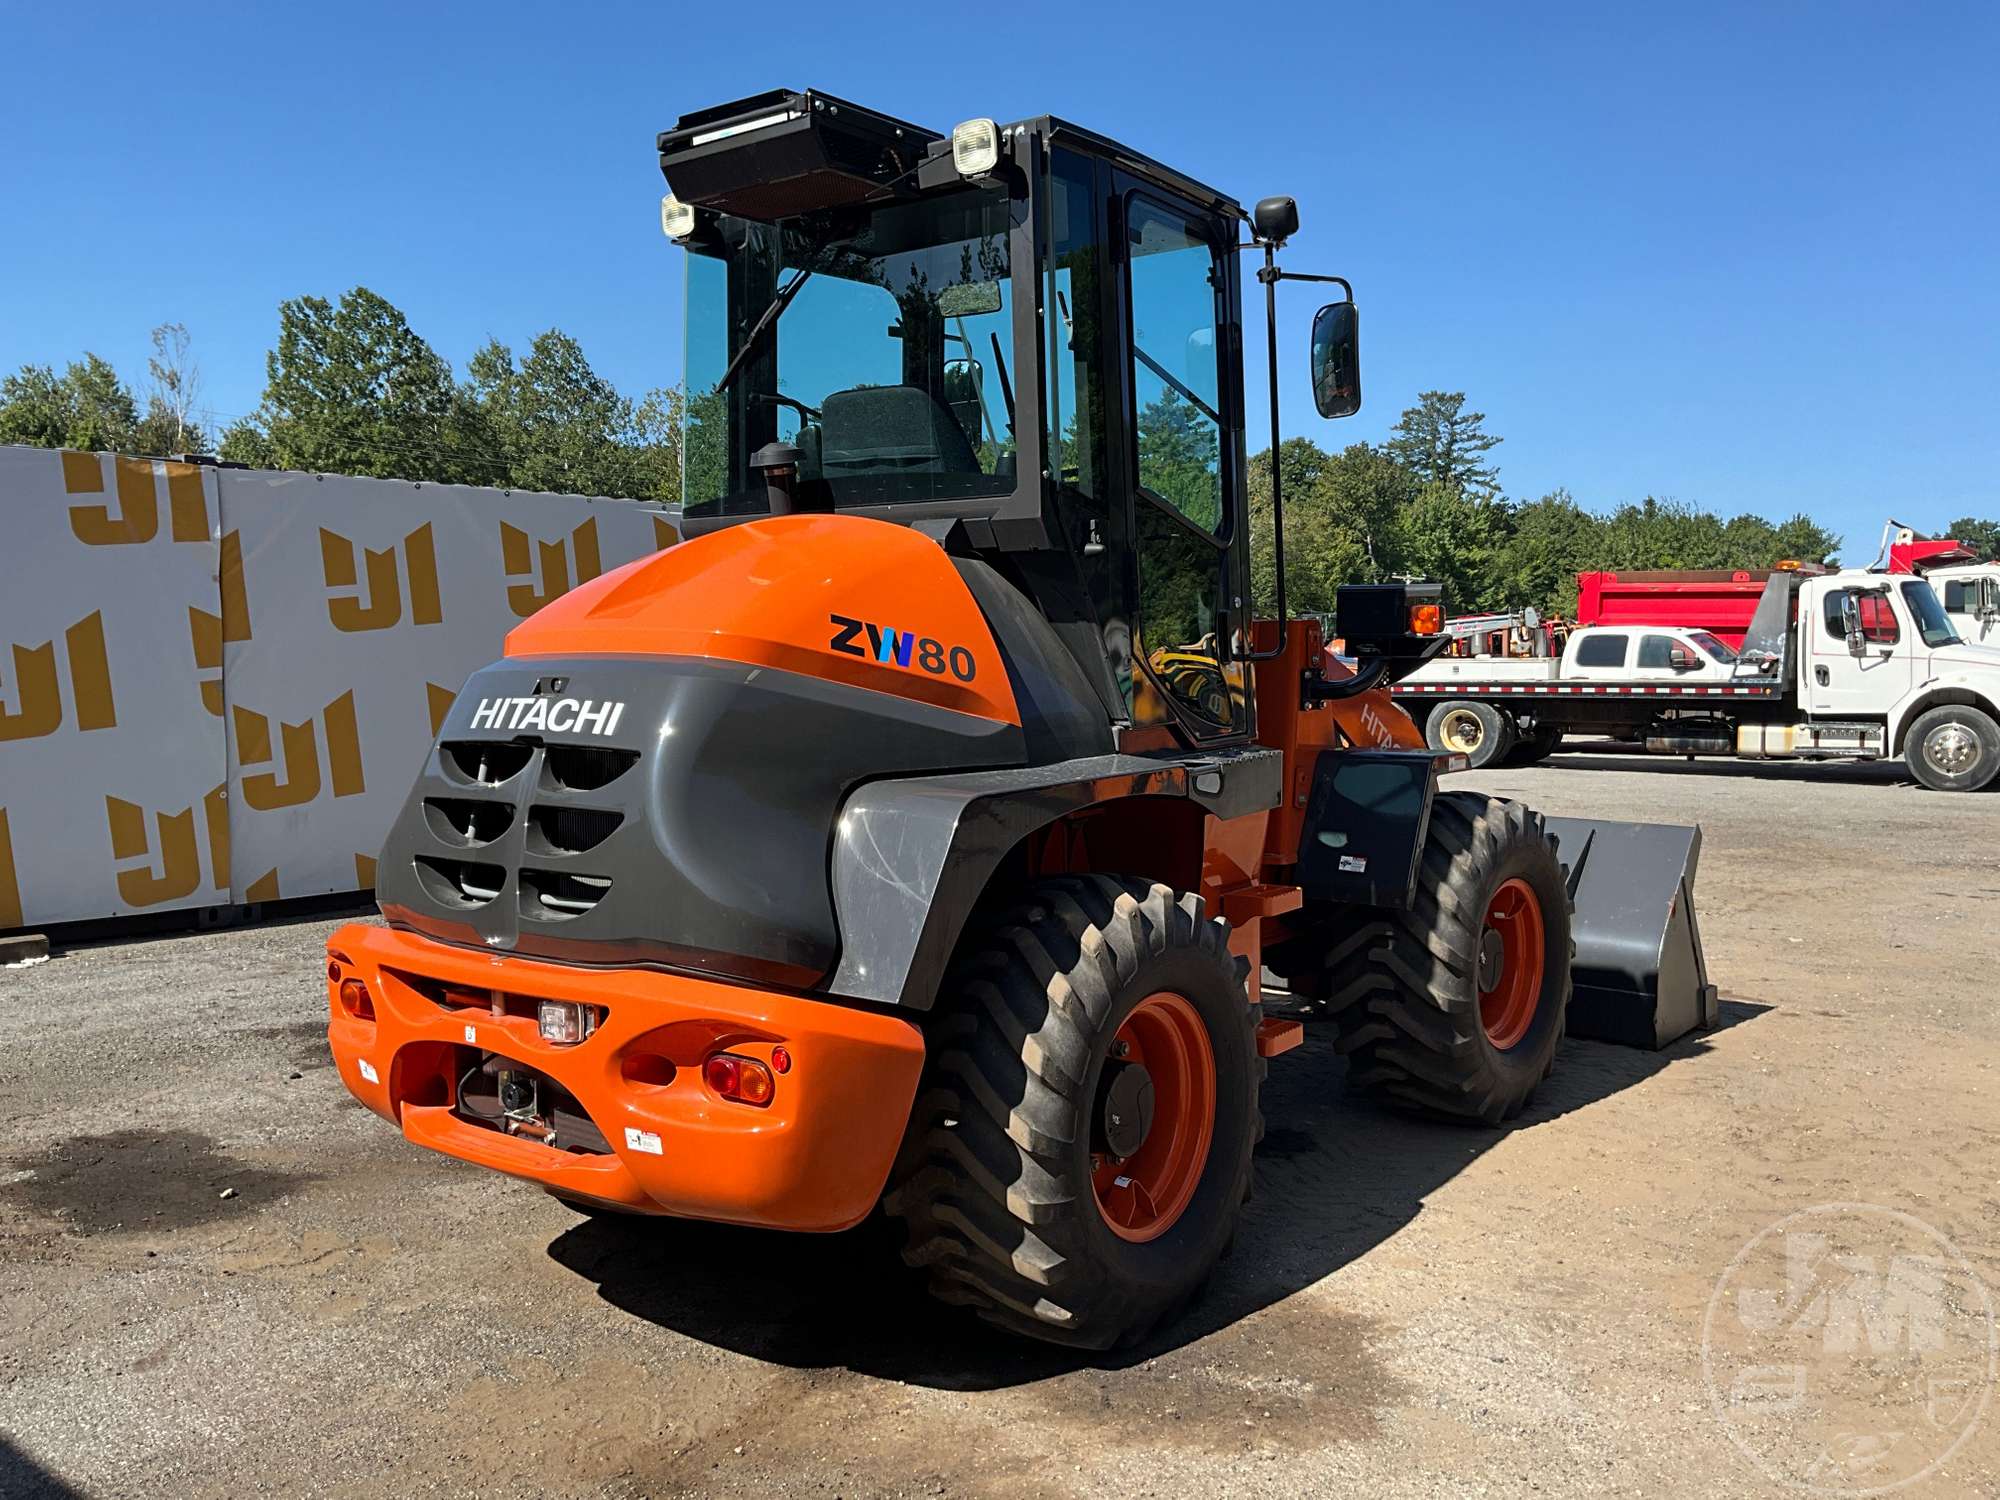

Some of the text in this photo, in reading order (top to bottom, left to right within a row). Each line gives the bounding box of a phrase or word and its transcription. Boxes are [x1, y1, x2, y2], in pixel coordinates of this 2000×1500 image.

[830, 613, 976, 682] ZW80
[470, 697, 625, 736] HITACHI
[1361, 703, 1401, 749] HITA
